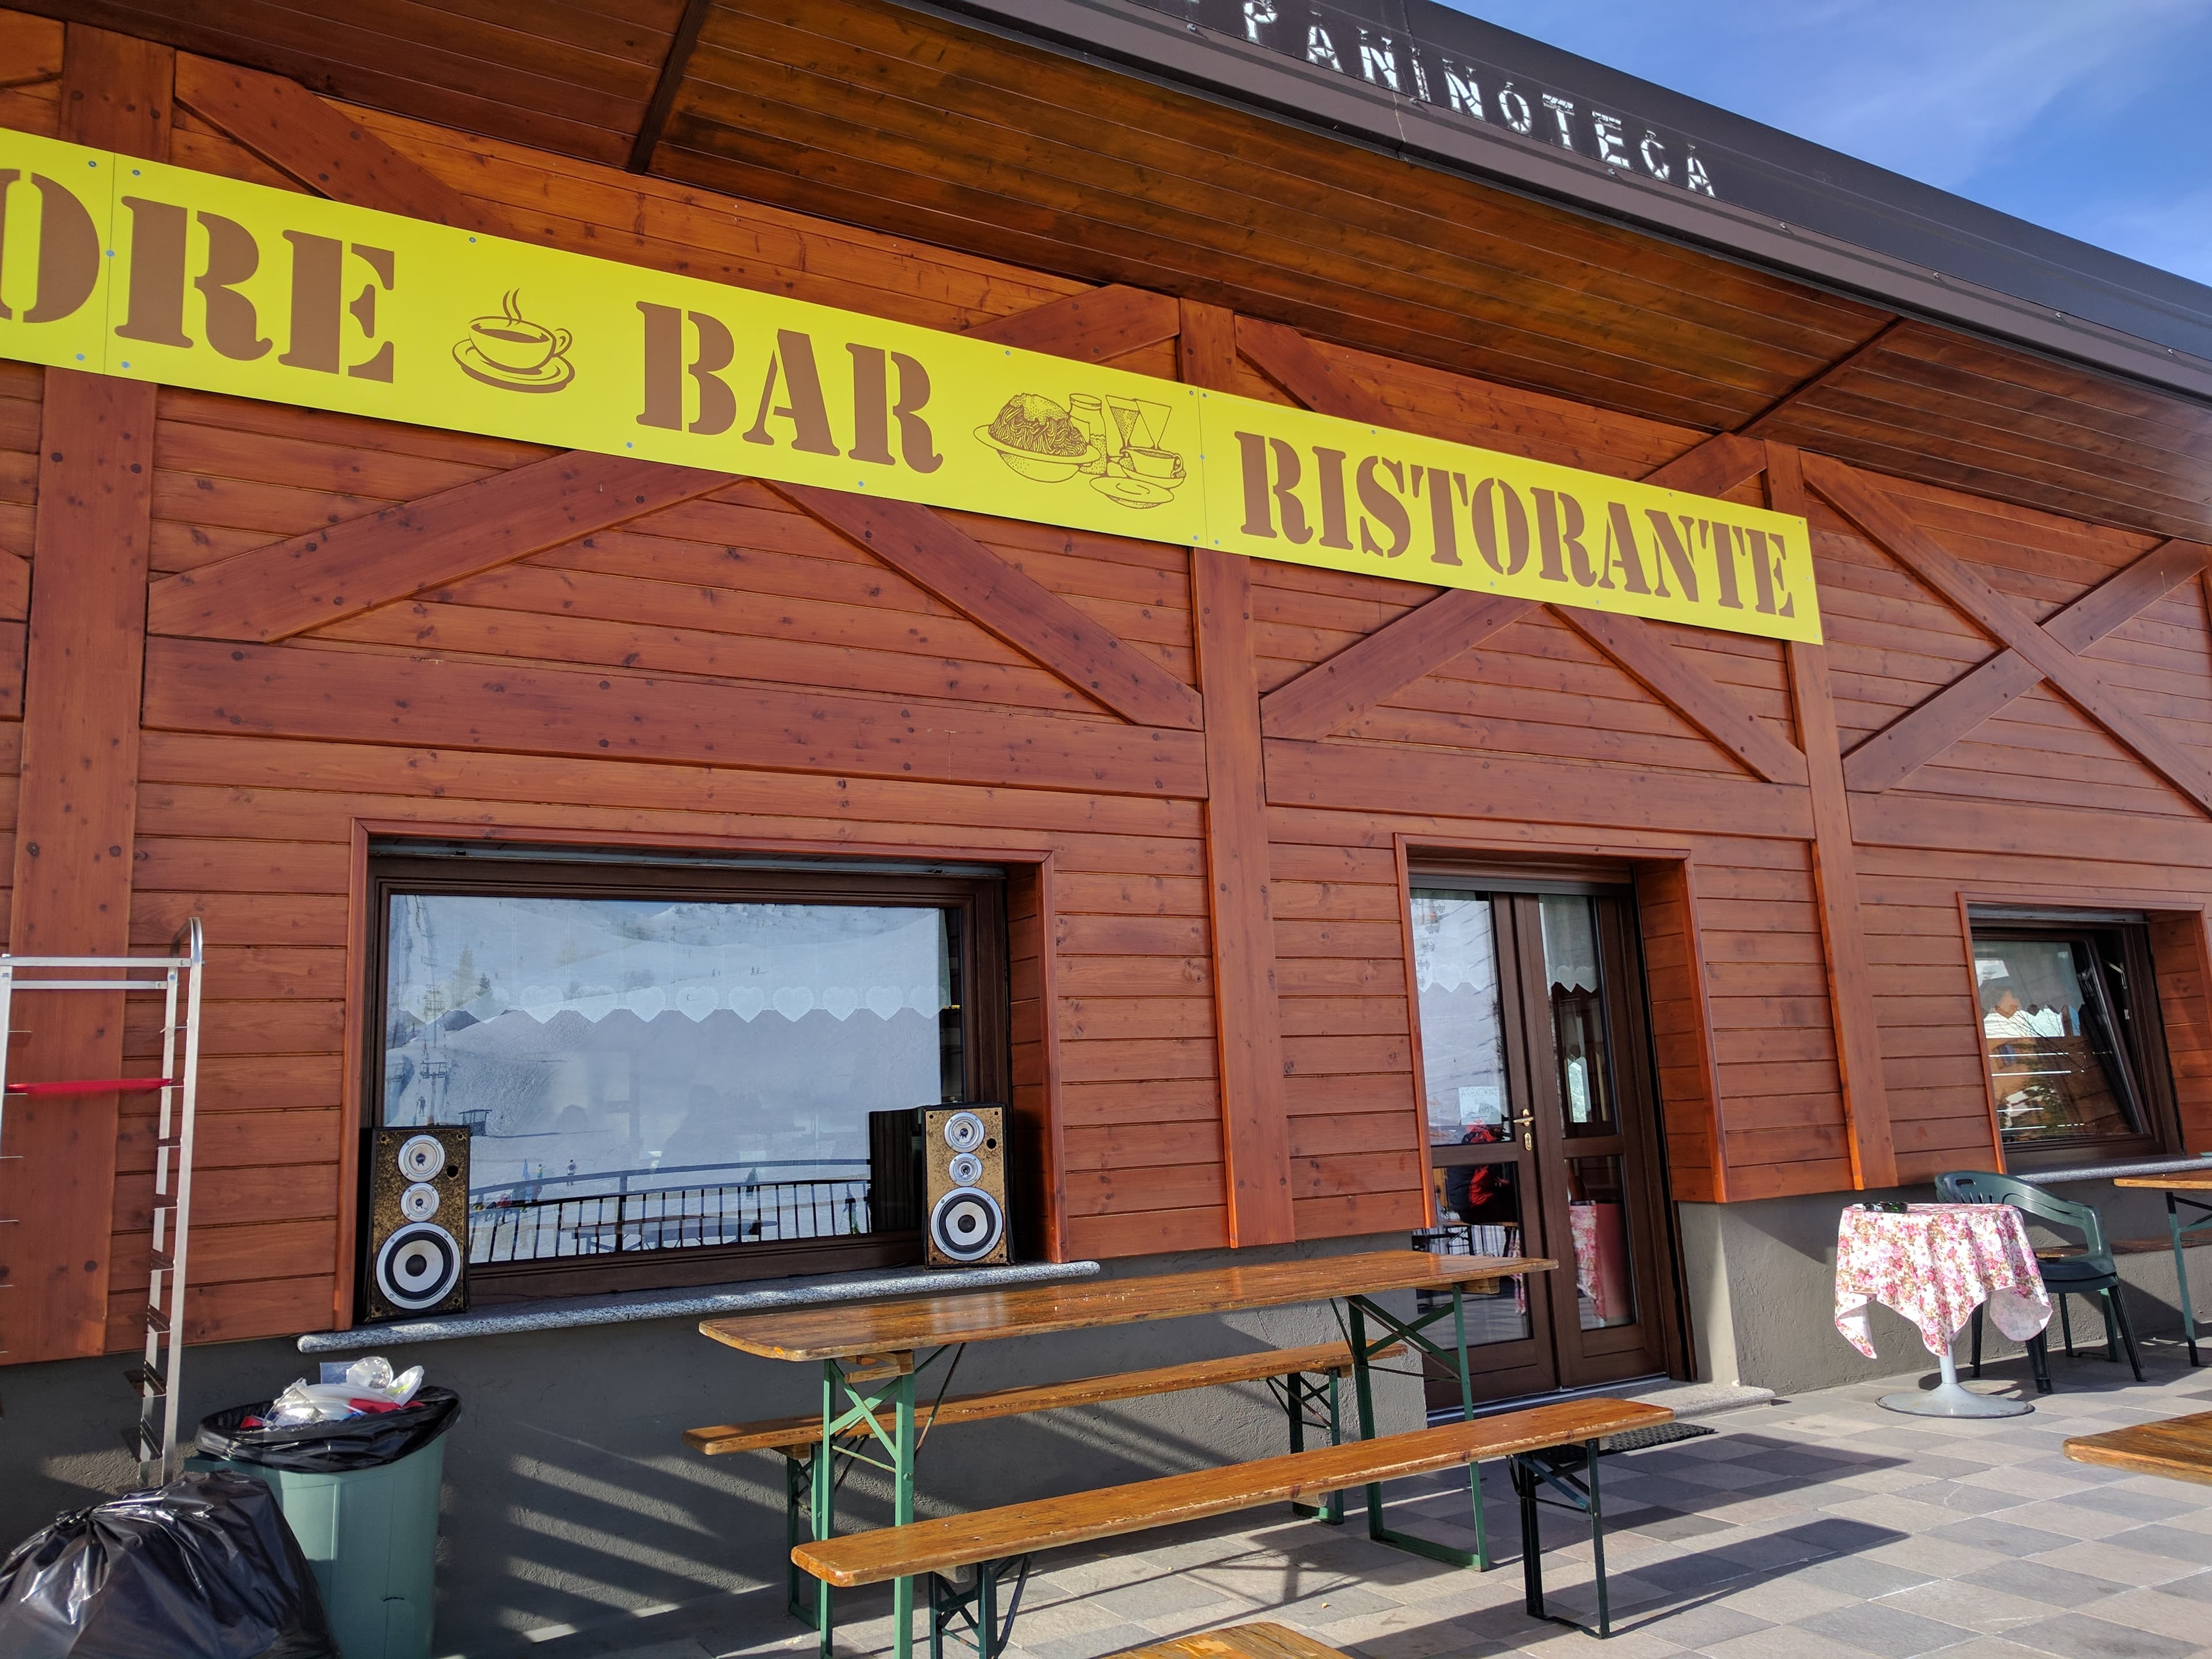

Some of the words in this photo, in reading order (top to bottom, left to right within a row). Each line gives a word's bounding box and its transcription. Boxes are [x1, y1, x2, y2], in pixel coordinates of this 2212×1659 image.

[1243, 0, 1716, 198] PANINOTECA
[635, 300, 945, 475] BAR
[1233, 430, 1797, 620] RISTORANTE
